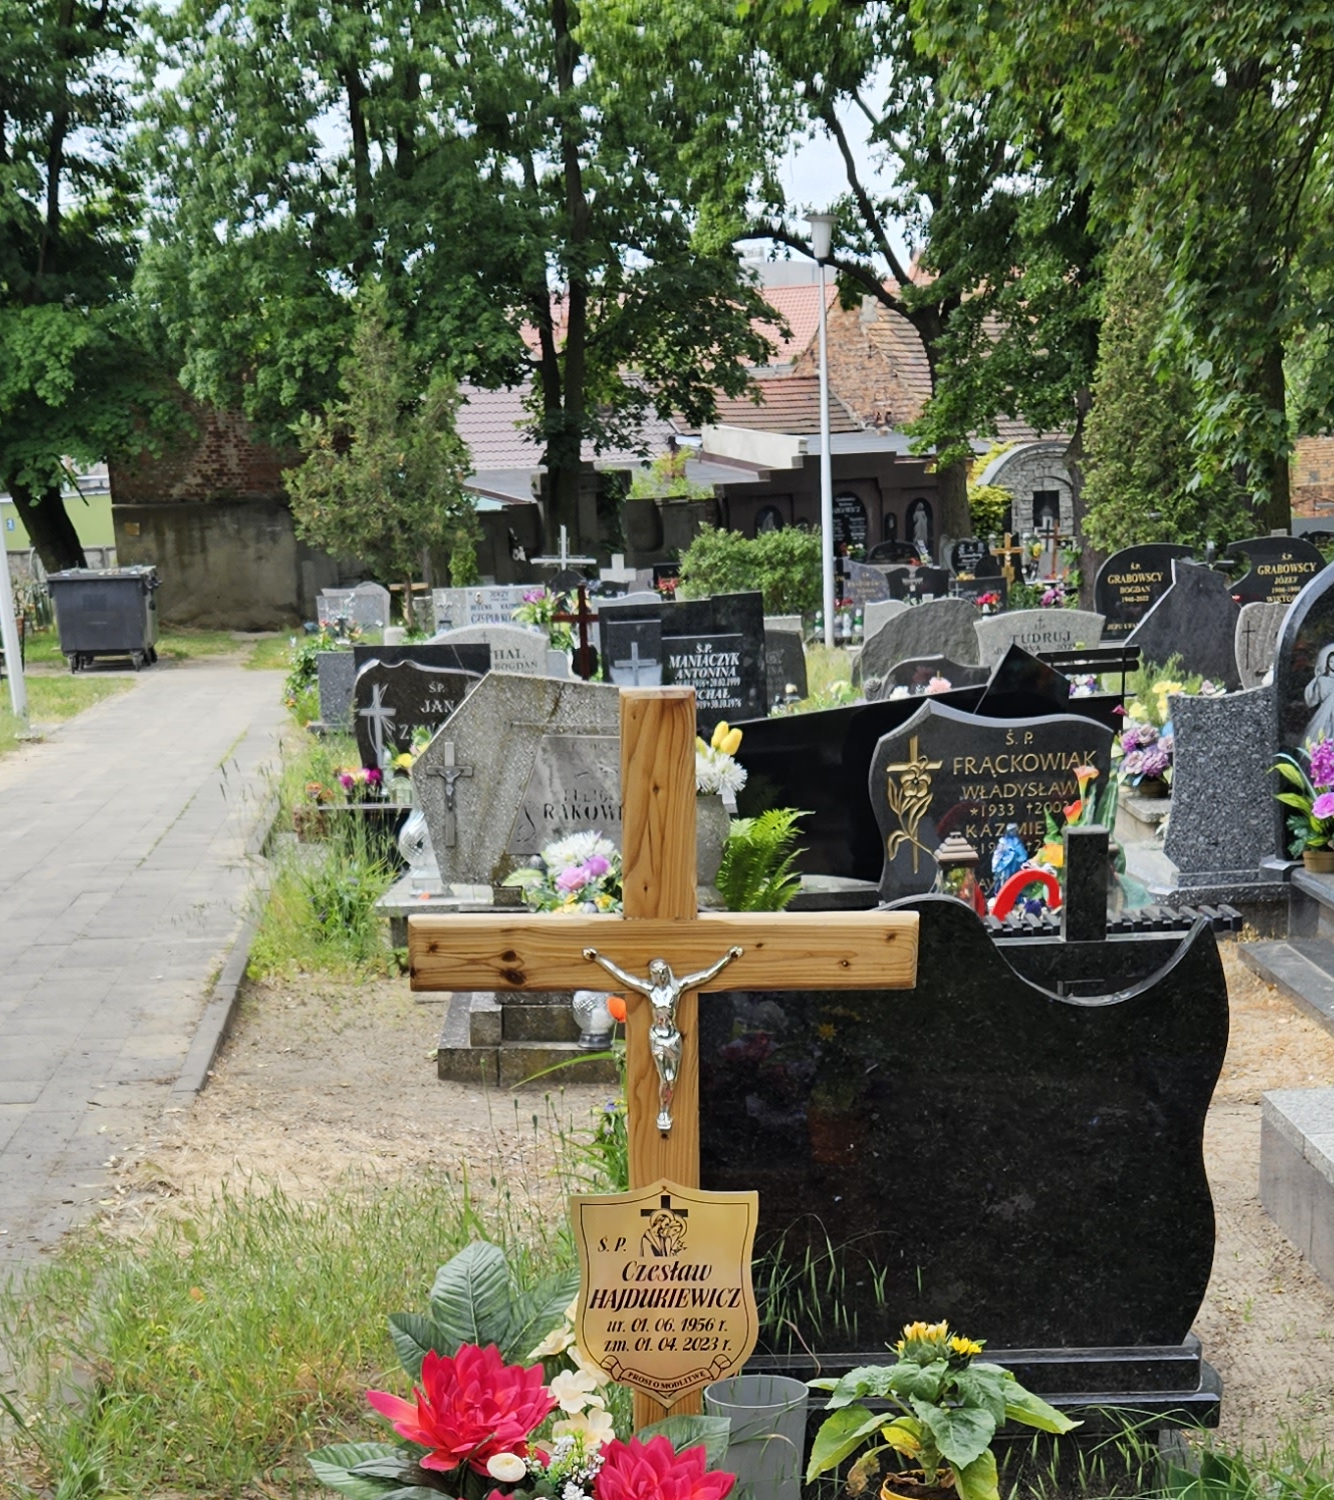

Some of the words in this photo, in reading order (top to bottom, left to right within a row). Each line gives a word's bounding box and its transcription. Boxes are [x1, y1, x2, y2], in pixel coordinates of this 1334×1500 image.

[1257, 562, 1316, 576] GRABOWSCY
[1107, 572, 1164, 584] GRABOWSCY
[1274, 576, 1299, 585] JÓZEF
[1120, 585, 1152, 594] BOGDAN
[1010, 631, 1071, 644] TUDRUJ
[494, 661, 537, 671] BOGDAN
[669, 652, 740, 668] MANIACZYK
[675, 667, 736, 680] ANTONINA
[696, 688, 730, 700] ICHAŁ
[420, 701, 455, 713] JAN
[953, 751, 1097, 778] FRĄCKOWIAK
[961, 781, 1078, 800] WŁADYSŁAW
[622, 1261, 712, 1283] Czesław
[589, 1288, 741, 1312] HAJDUKIEWICZ
[607, 1321, 625, 1333] ur.
[631, 1318, 649, 1333] 01.
[655, 1318, 676, 1333] 06.
[681, 1318, 716, 1332] 1956
[718, 1320, 728, 1332] r.
[604, 1340, 629, 1352] zm.
[635, 1337, 653, 1351] 01.
[658, 1337, 678, 1351] 04.
[683, 1337, 719, 1351] 2023
[723, 1338, 732, 1351] r.
